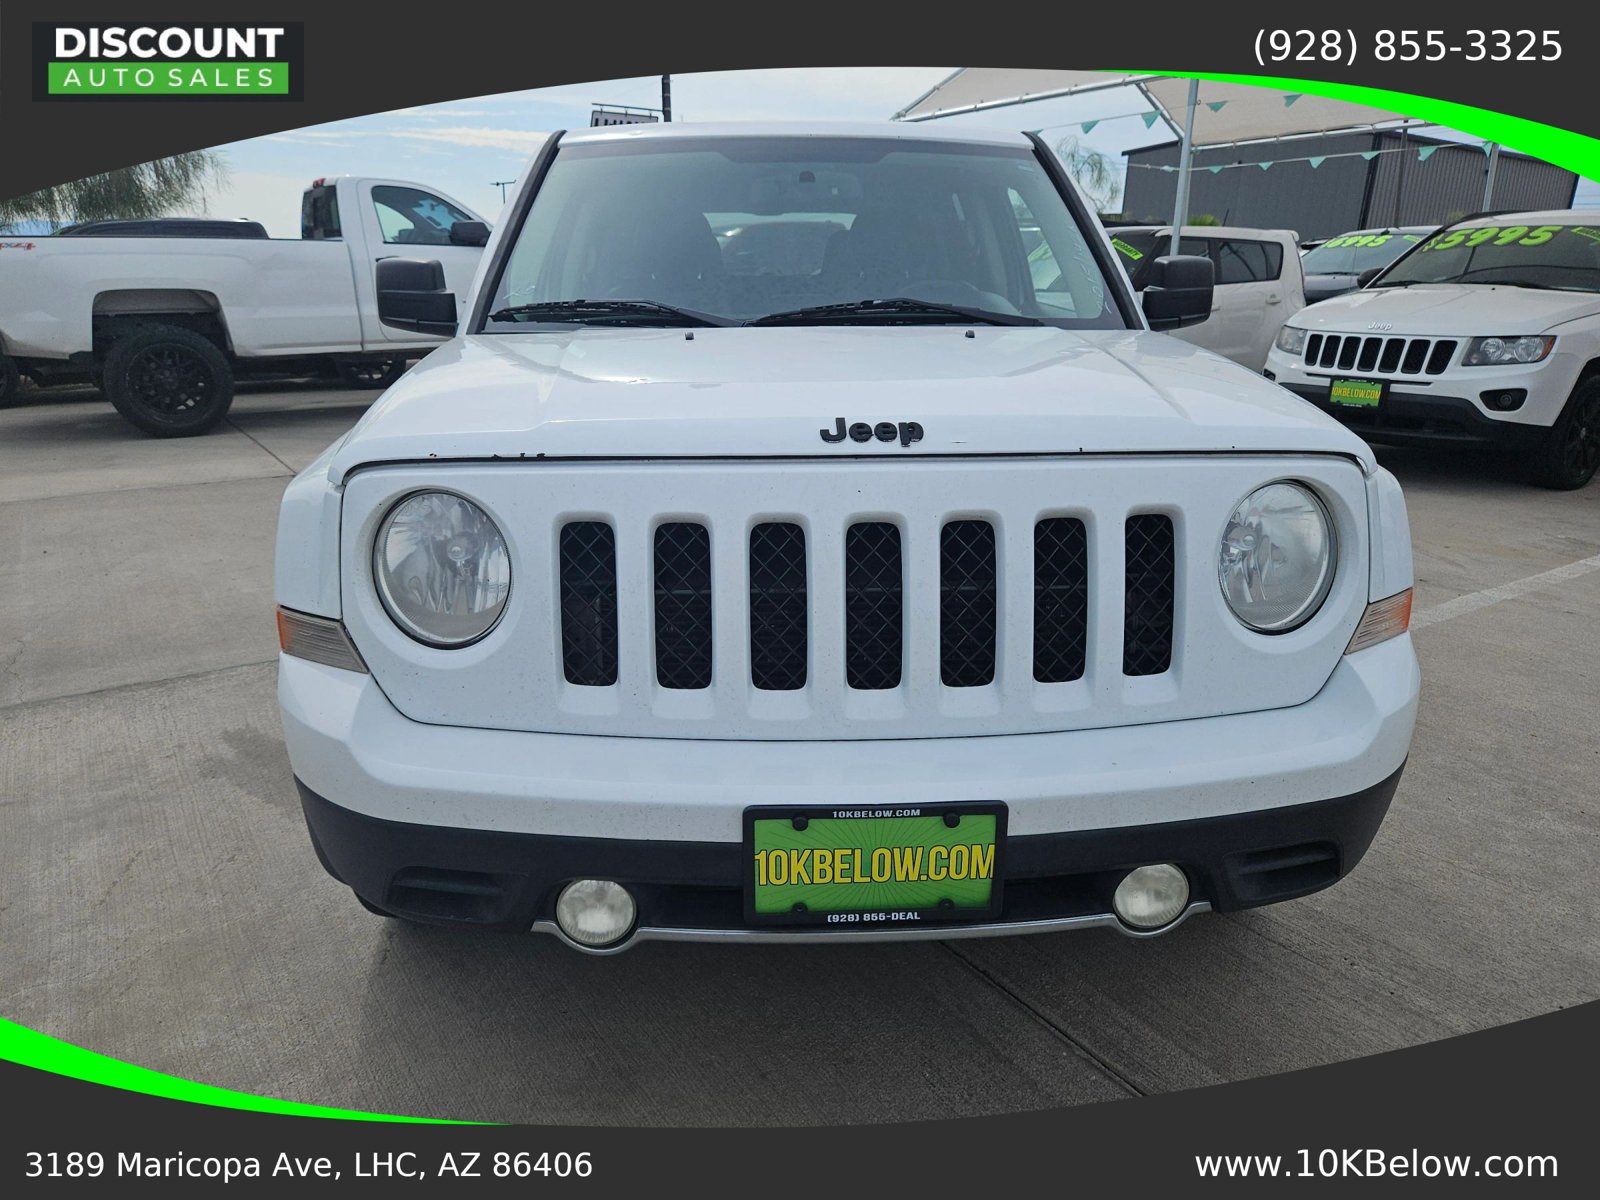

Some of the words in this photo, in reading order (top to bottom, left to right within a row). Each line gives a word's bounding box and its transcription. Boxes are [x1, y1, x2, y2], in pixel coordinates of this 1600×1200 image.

[1423, 225, 1563, 252] $5995
[1368, 322, 1392, 331] Jeep
[819, 417, 924, 448] Jeep
[832, 809, 921, 818] 10KBELOW.COM
[754, 844, 996, 886] 10KBELOW.COM
[827, 914, 860, 923] (928)
[863, 911, 921, 922] 855-DEAL
